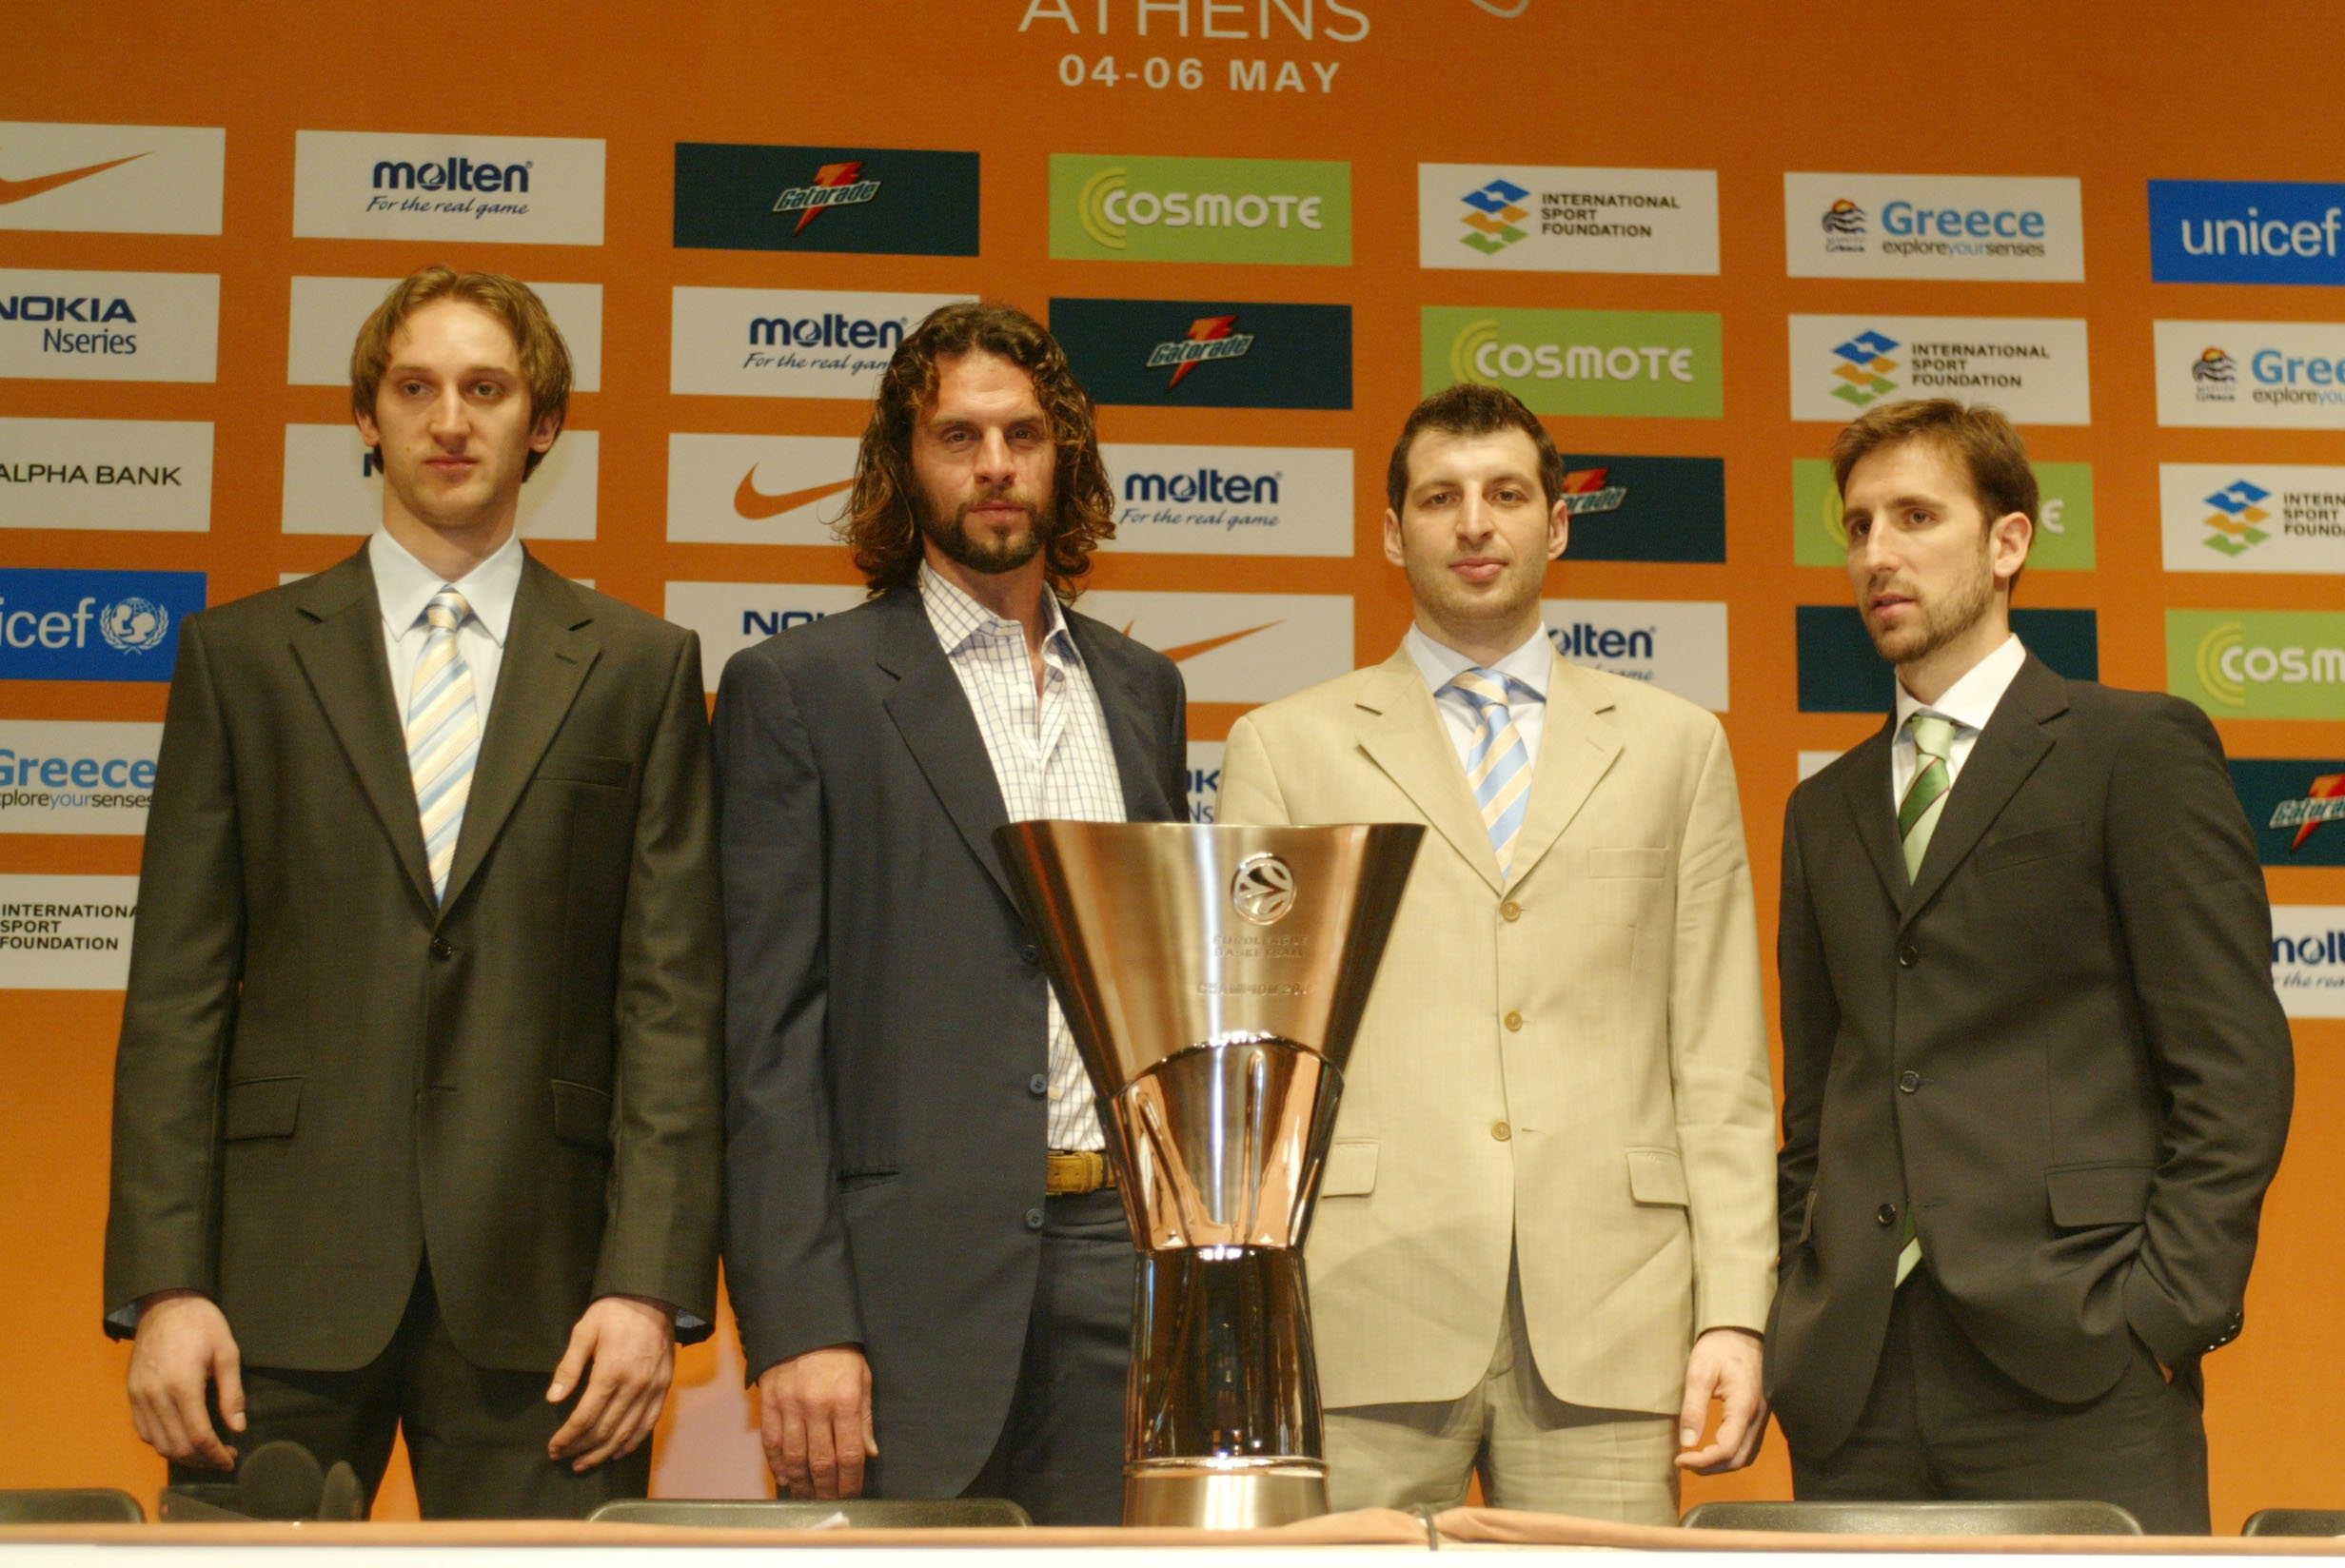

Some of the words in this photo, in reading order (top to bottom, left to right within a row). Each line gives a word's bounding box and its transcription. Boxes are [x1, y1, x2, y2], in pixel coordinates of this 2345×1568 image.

[1018, 0, 1370, 43] ATHENS
[1058, 54, 1204, 89] 04-06
[1230, 59, 1340, 93] MAY
[373, 157, 529, 192] molten
[366, 196, 397, 212] For
[401, 197, 431, 213] the
[434, 198, 475, 213] real
[475, 204, 529, 220] game
[777, 182, 879, 210] Gatorade
[1103, 189, 1322, 229] COSMOTE
[1542, 193, 1680, 209] INTERNATIONAL
[1541, 207, 1597, 222] SPORT
[1882, 200, 2045, 238] Greece
[1542, 223, 1652, 237] FOUNDATION
[2181, 206, 2342, 257] unicef
[43, 327, 137, 355] Nseries
[749, 313, 904, 349] molten
[1151, 335, 1251, 363] Gatorade
[1911, 343, 2050, 359] INTERNATIONAL
[743, 352, 773, 369] For
[777, 353, 807, 369] the
[811, 354, 852, 369] real
[852, 361, 891, 376] gam
[1475, 343, 1694, 382] COSMOTE
[1911, 359, 1967, 372] SPORT
[1911, 374, 2022, 388] FOUNDATION
[0, 464, 89, 483] ALPHA
[96, 465, 182, 486] BANK
[1125, 469, 1278, 504] molten
[1119, 507, 1150, 524] For
[1153, 508, 1183, 524] the
[1186, 509, 1227, 524] real
[1226, 516, 1280, 531] game
[2284, 508, 2337, 519] SPORT
[1547, 623, 1653, 658] olten
[0, 920, 62, 933] SPORT
[0, 936, 119, 951] FOUNDATION
